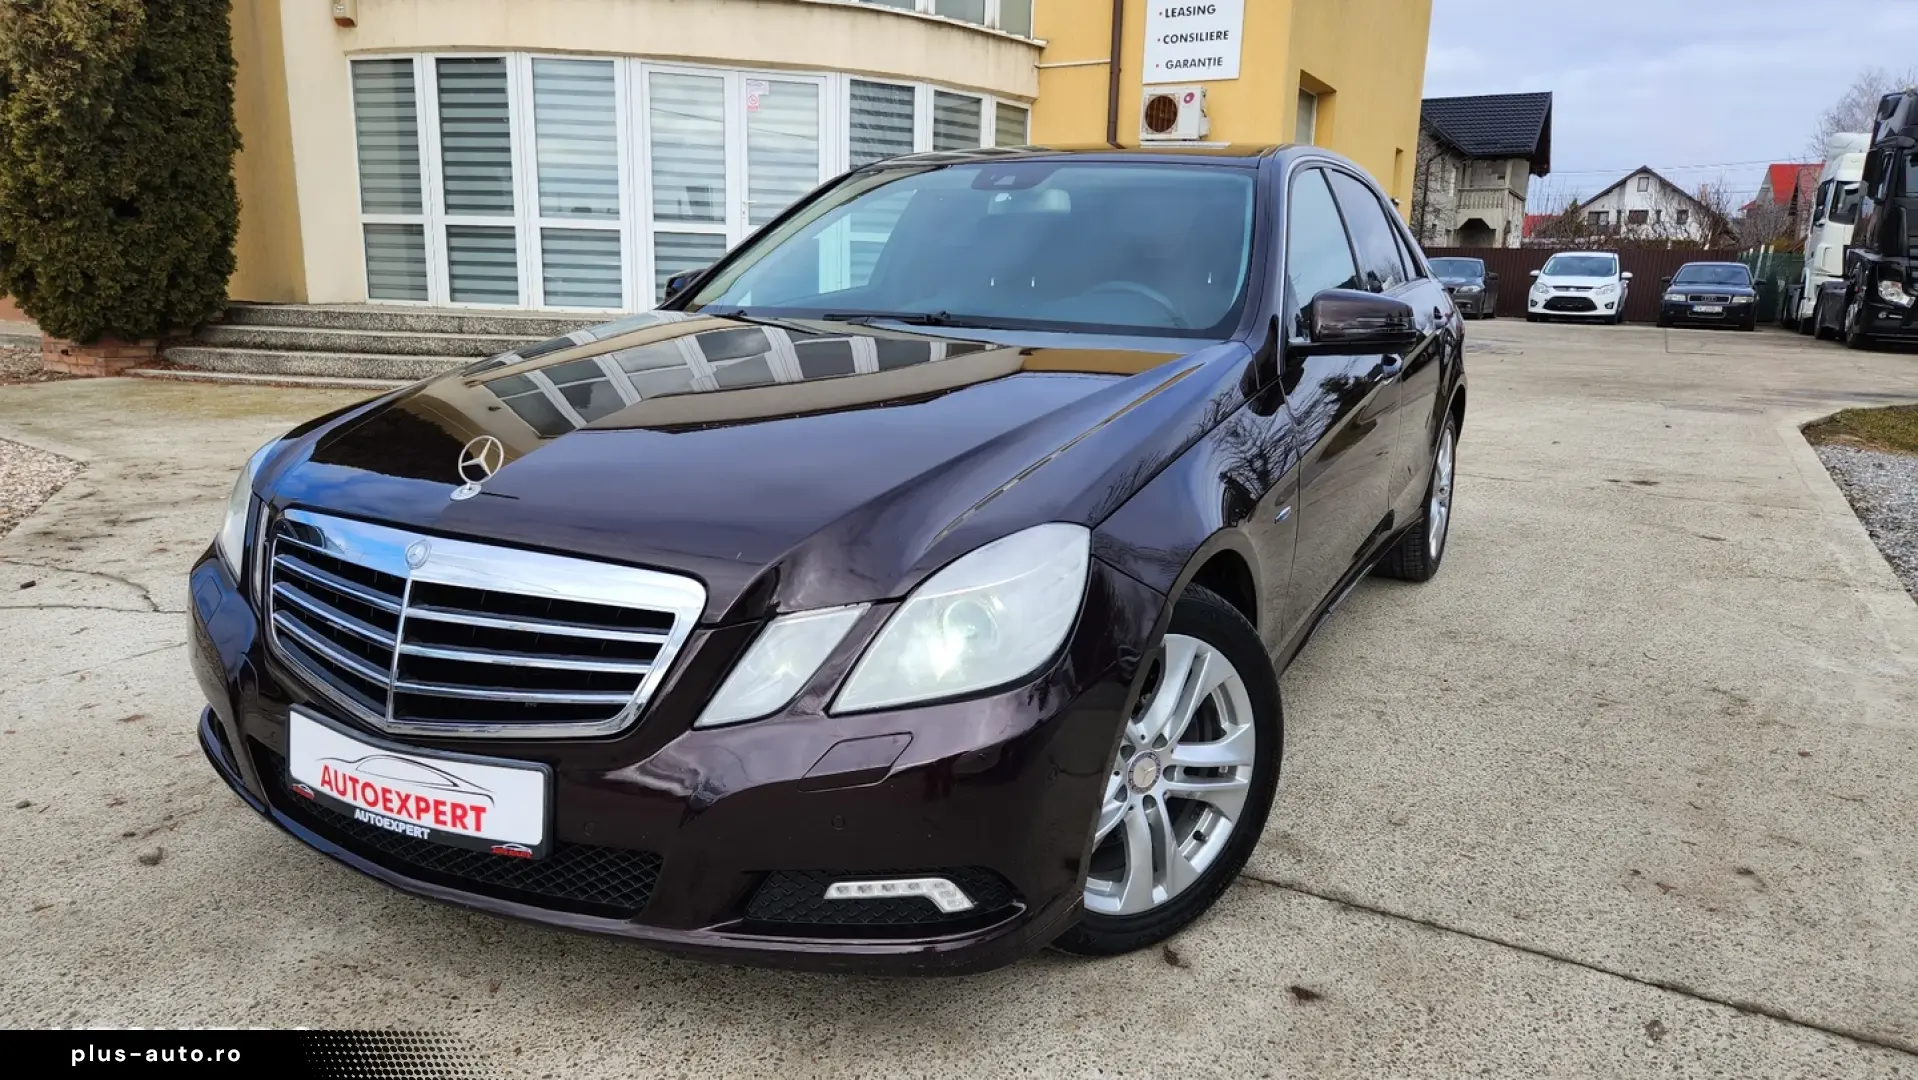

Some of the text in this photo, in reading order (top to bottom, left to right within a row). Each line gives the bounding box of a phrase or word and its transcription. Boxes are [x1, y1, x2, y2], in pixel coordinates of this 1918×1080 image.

[1165, 4, 1217, 18] LEASING
[1163, 30, 1229, 45] CONSILIERE
[320, 764, 487, 832] AUTOEXPERT
[354, 808, 431, 840] AUTOEXPERT
